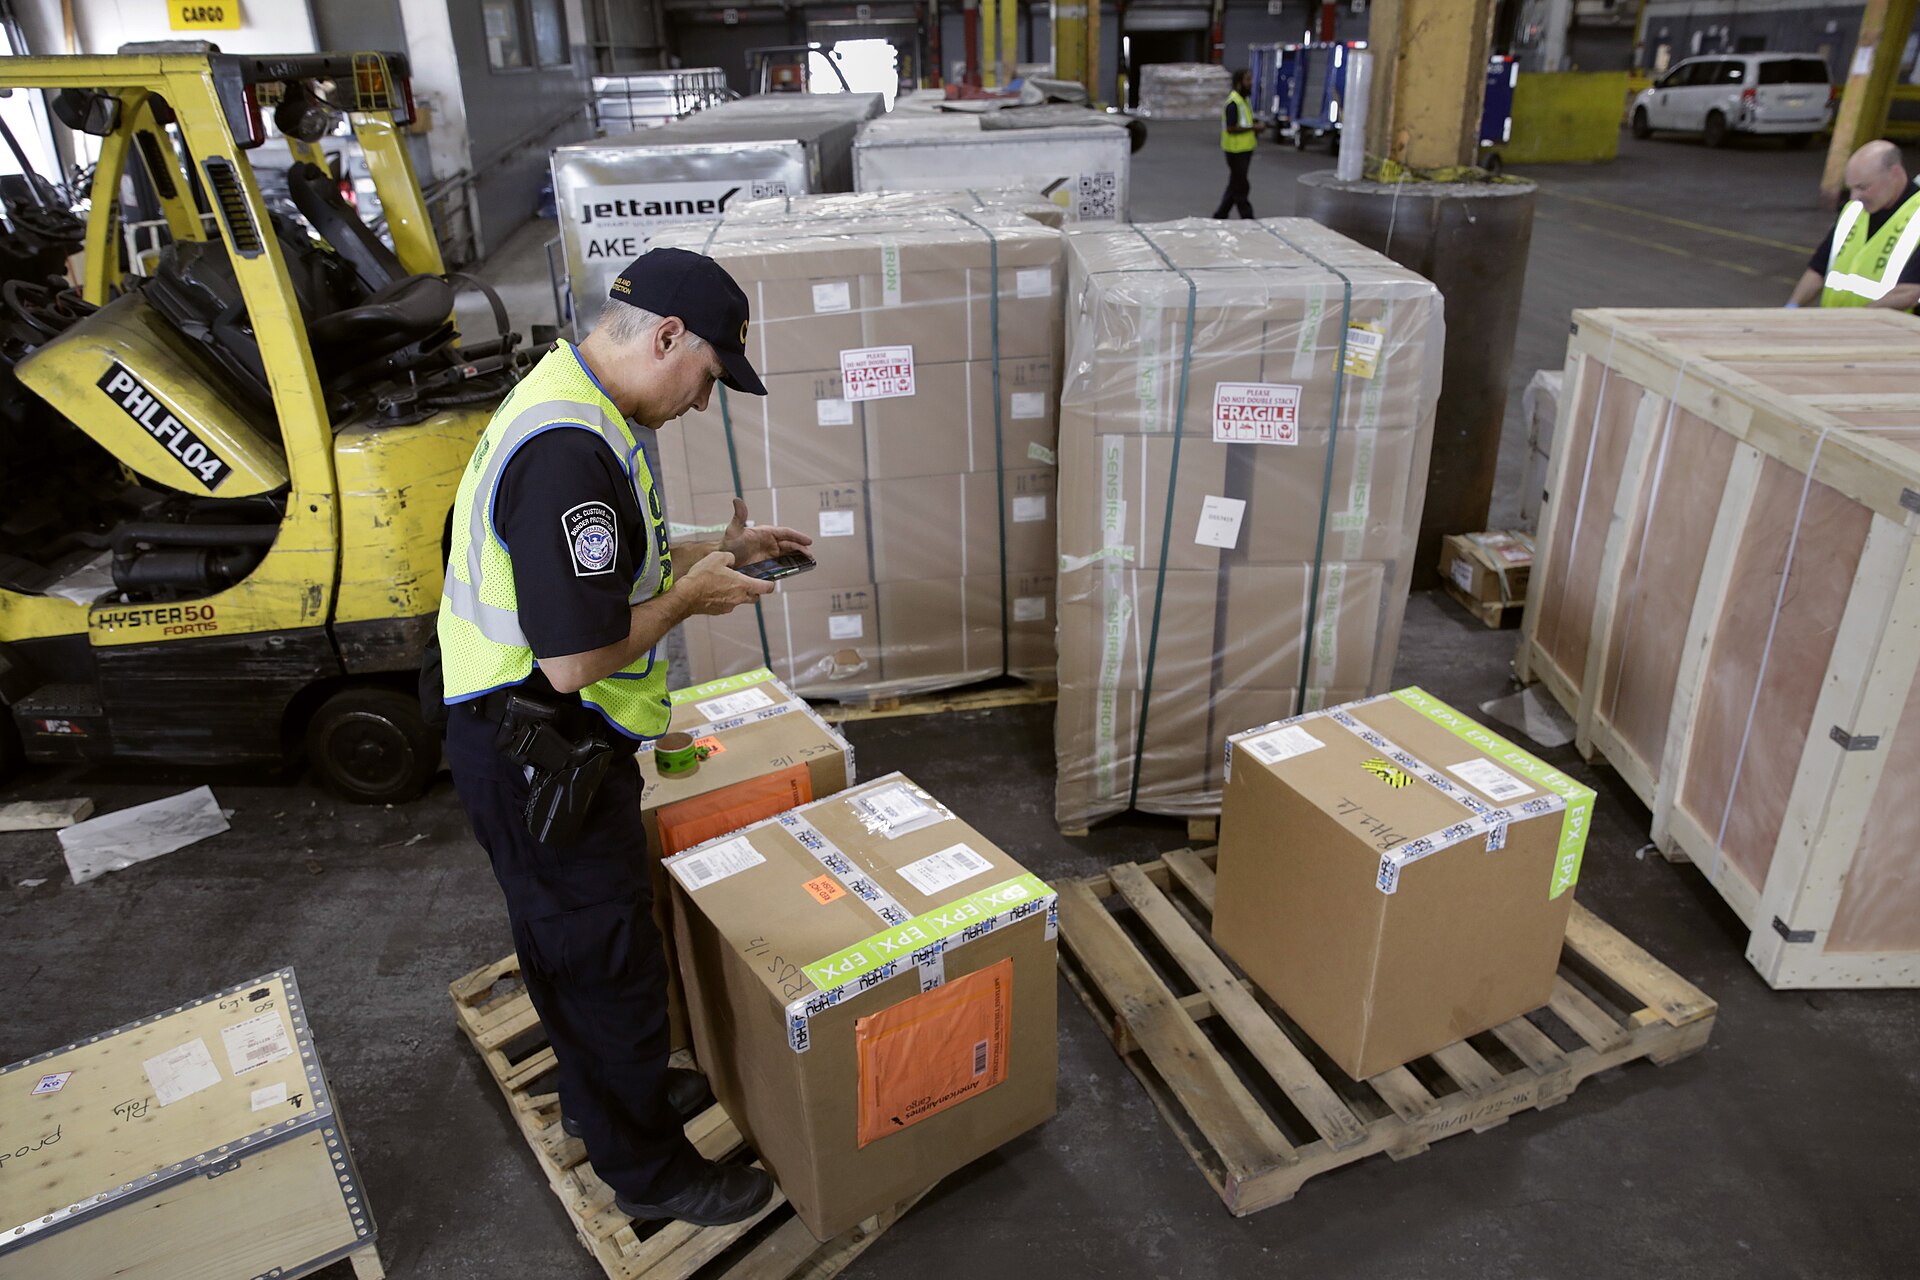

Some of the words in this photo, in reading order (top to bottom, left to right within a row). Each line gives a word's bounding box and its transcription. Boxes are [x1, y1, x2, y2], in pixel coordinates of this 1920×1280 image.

[182, 6, 225, 22] CARGO
[588, 237, 636, 258] AKE
[846, 365, 910, 382] FRAGILE
[1232, 396, 1246, 404] NOT
[1247, 396, 1273, 405] DOUBLE
[1274, 397, 1294, 405] STACK
[1246, 389, 1271, 397] PLEASE
[1218, 405, 1294, 422] FRAGILE
[106, 370, 222, 482] PHLFL04
[582, 507, 606, 517] CUSTOMS
[570, 518, 590, 537] BORDER
[589, 516, 615, 534] PROTECTION
[99, 607, 182, 629] HYSTER
[184, 604, 215, 621] 50
[163, 621, 218, 636] FORTIS
[697, 681, 732, 696] EPX
[1398, 689, 1430, 708] EPX
[1429, 707, 1463, 729] EPX
[1465, 729, 1501, 751] EPX
[1503, 752, 1541, 774] EPX
[1542, 774, 1582, 801] EPX
[1567, 805, 1586, 842] EPX
[1558, 853, 1576, 887] EPX
[807, 882, 821, 894] HOT
[819, 891, 832, 901] RED
[820, 880, 836, 894] RUSH
[981, 884, 1030, 908] EPX
[933, 903, 981, 929] EPX
[877, 925, 928, 953] EPX
[911, 940, 949, 967] JOHAU
[818, 952, 869, 981] EPX
[859, 963, 899, 991] JOHAU
[805, 990, 844, 1018] JOHAU
[794, 1015, 808, 1051] JOHAU
[905, 1096, 932, 1112] Cargo
